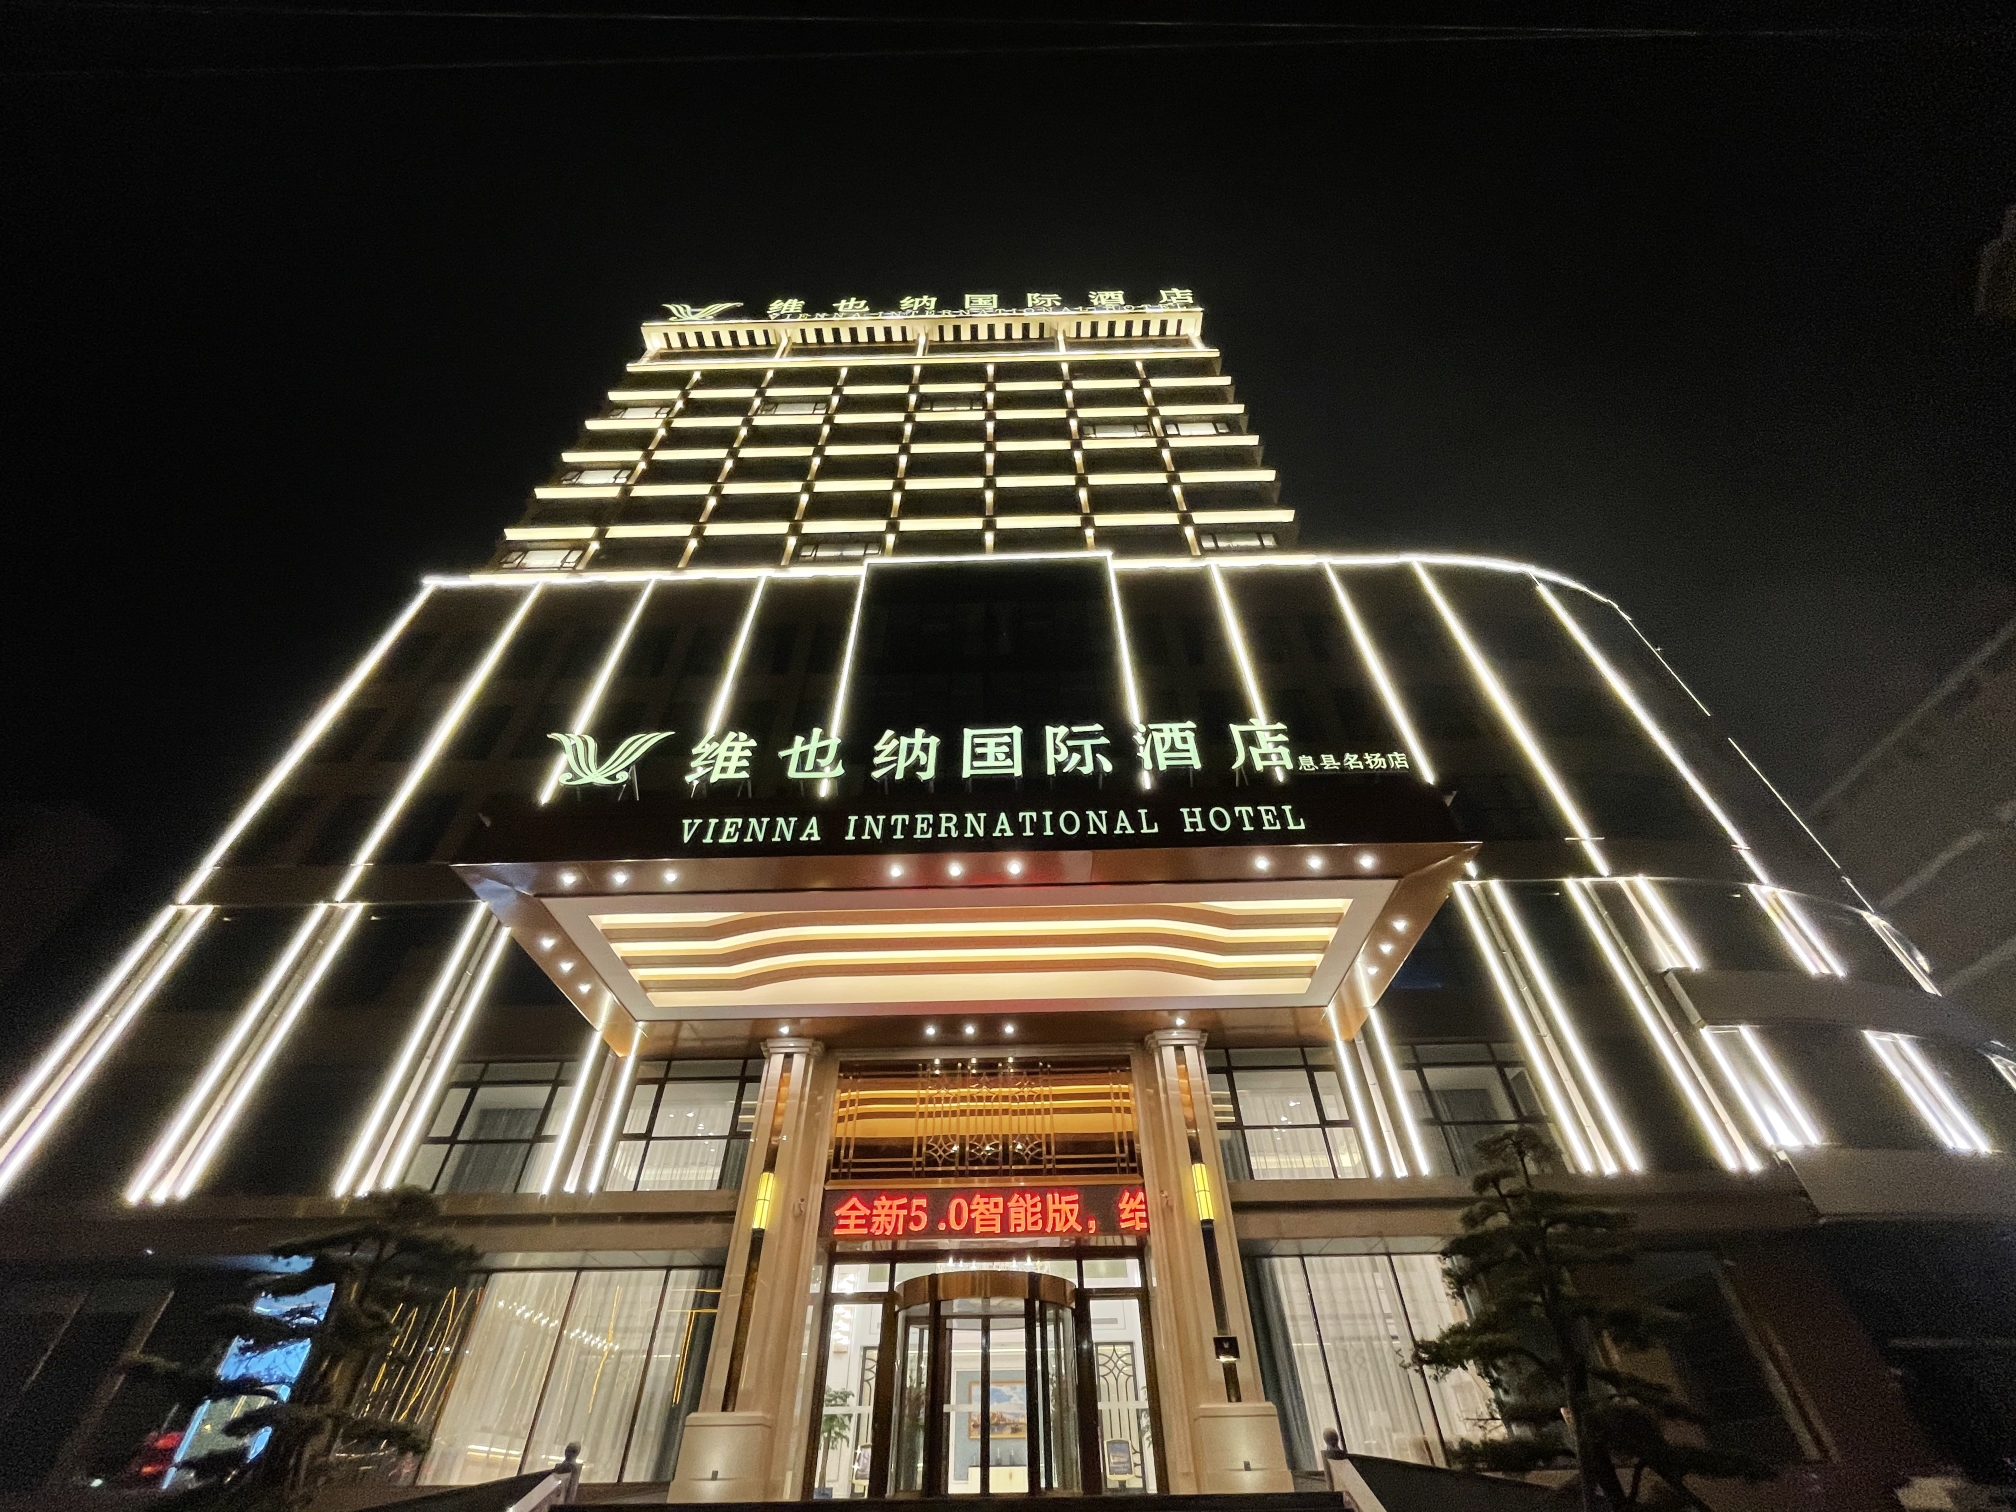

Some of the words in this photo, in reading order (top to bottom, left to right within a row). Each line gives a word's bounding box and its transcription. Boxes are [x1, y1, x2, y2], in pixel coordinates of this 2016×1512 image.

[766, 288, 1194, 314] 维也纳国际酒店
[684, 718, 1294, 784] 维也纳国际酒店
[1297, 751, 1411, 772] 息县名扬店
[681, 815, 822, 844] VIENNA
[844, 808, 1159, 841] INTERNATIONAL
[1180, 804, 1306, 833] HOTEL
